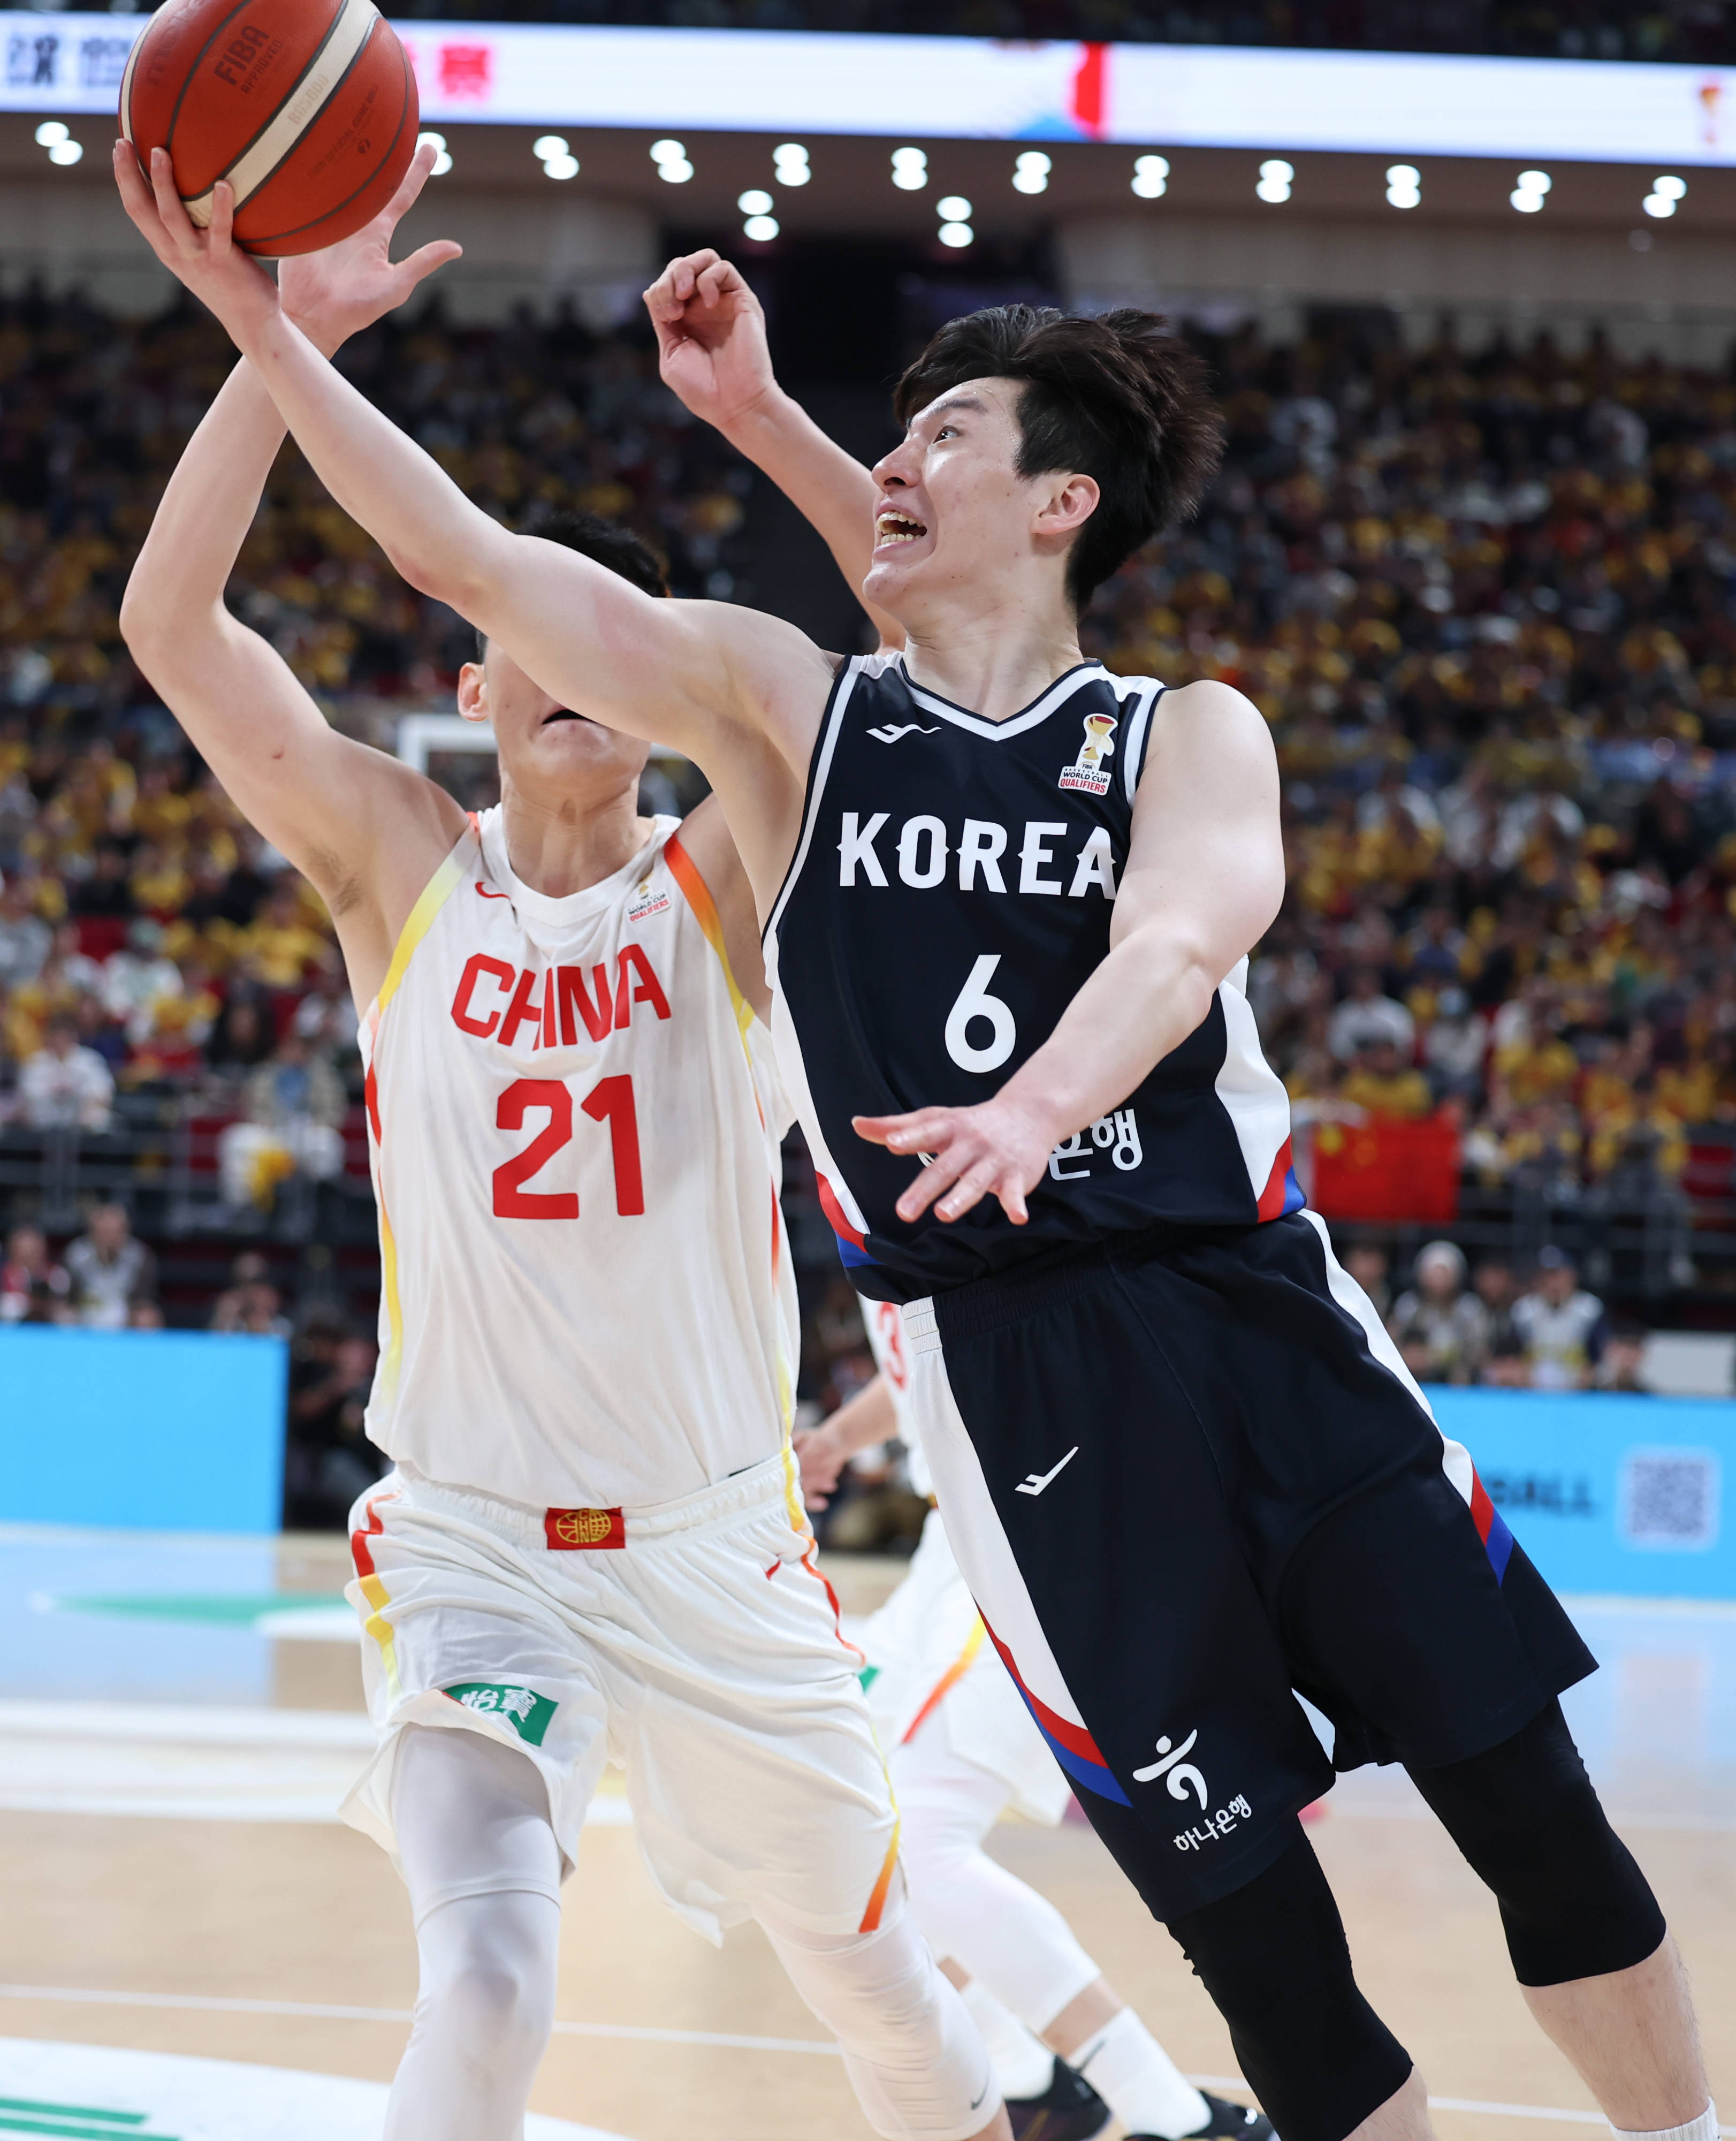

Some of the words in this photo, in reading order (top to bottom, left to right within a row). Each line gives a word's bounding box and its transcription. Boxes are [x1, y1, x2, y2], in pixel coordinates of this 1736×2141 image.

[214, 25, 270, 86] FIBA
[240, 39, 283, 94] APPROVED
[1060, 778, 1106, 793] QUALIFIERS
[1063, 772, 1090, 780] WORLD
[1092, 776, 1108, 784] CUP
[836, 812, 1117, 900] KOREA
[630, 899, 669, 922] QUALIFIERS
[451, 943, 672, 1051] CHINA
[945, 954, 1016, 1073] 6
[492, 1074, 645, 1219] 21
[1173, 1793, 1252, 1851] 하나은행
